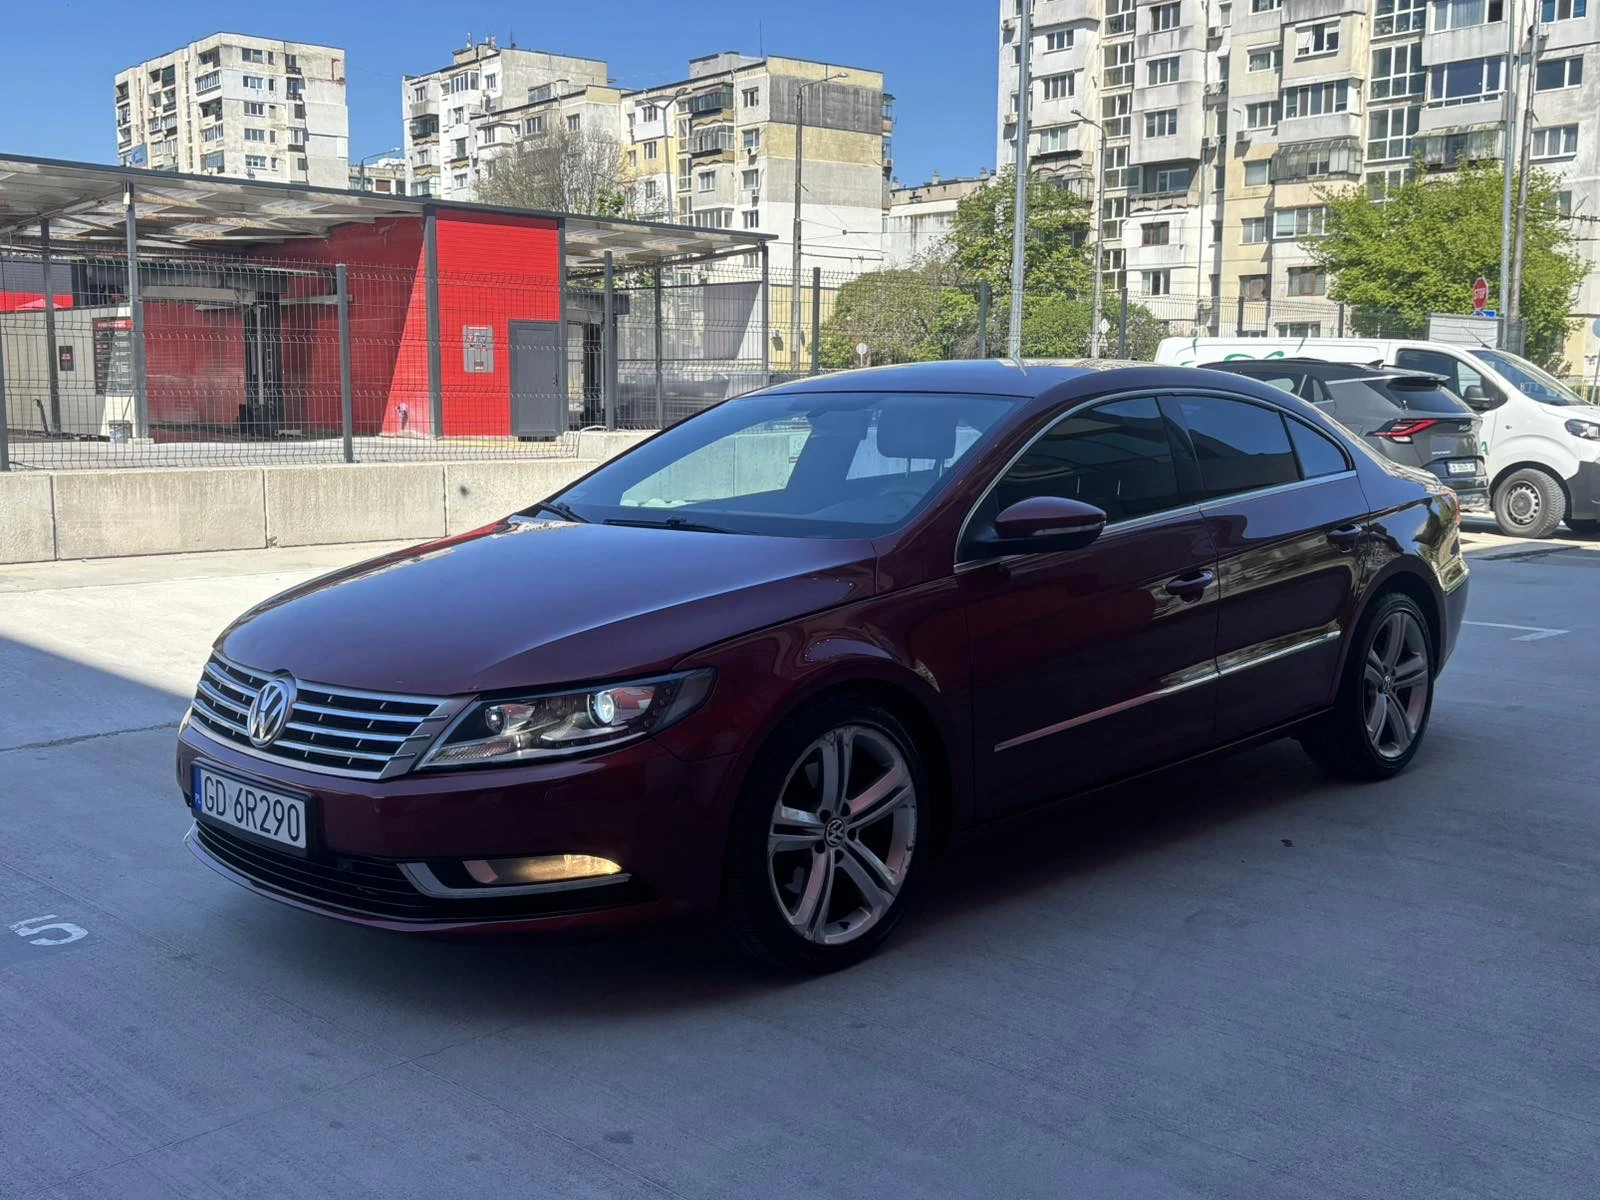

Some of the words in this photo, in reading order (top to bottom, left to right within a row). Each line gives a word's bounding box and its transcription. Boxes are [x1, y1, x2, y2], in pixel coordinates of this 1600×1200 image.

[1474, 287, 1486, 300] STOP
[204, 775, 227, 817] GD
[233, 787, 300, 842] 6R290
[8, 913, 89, 946] 5
